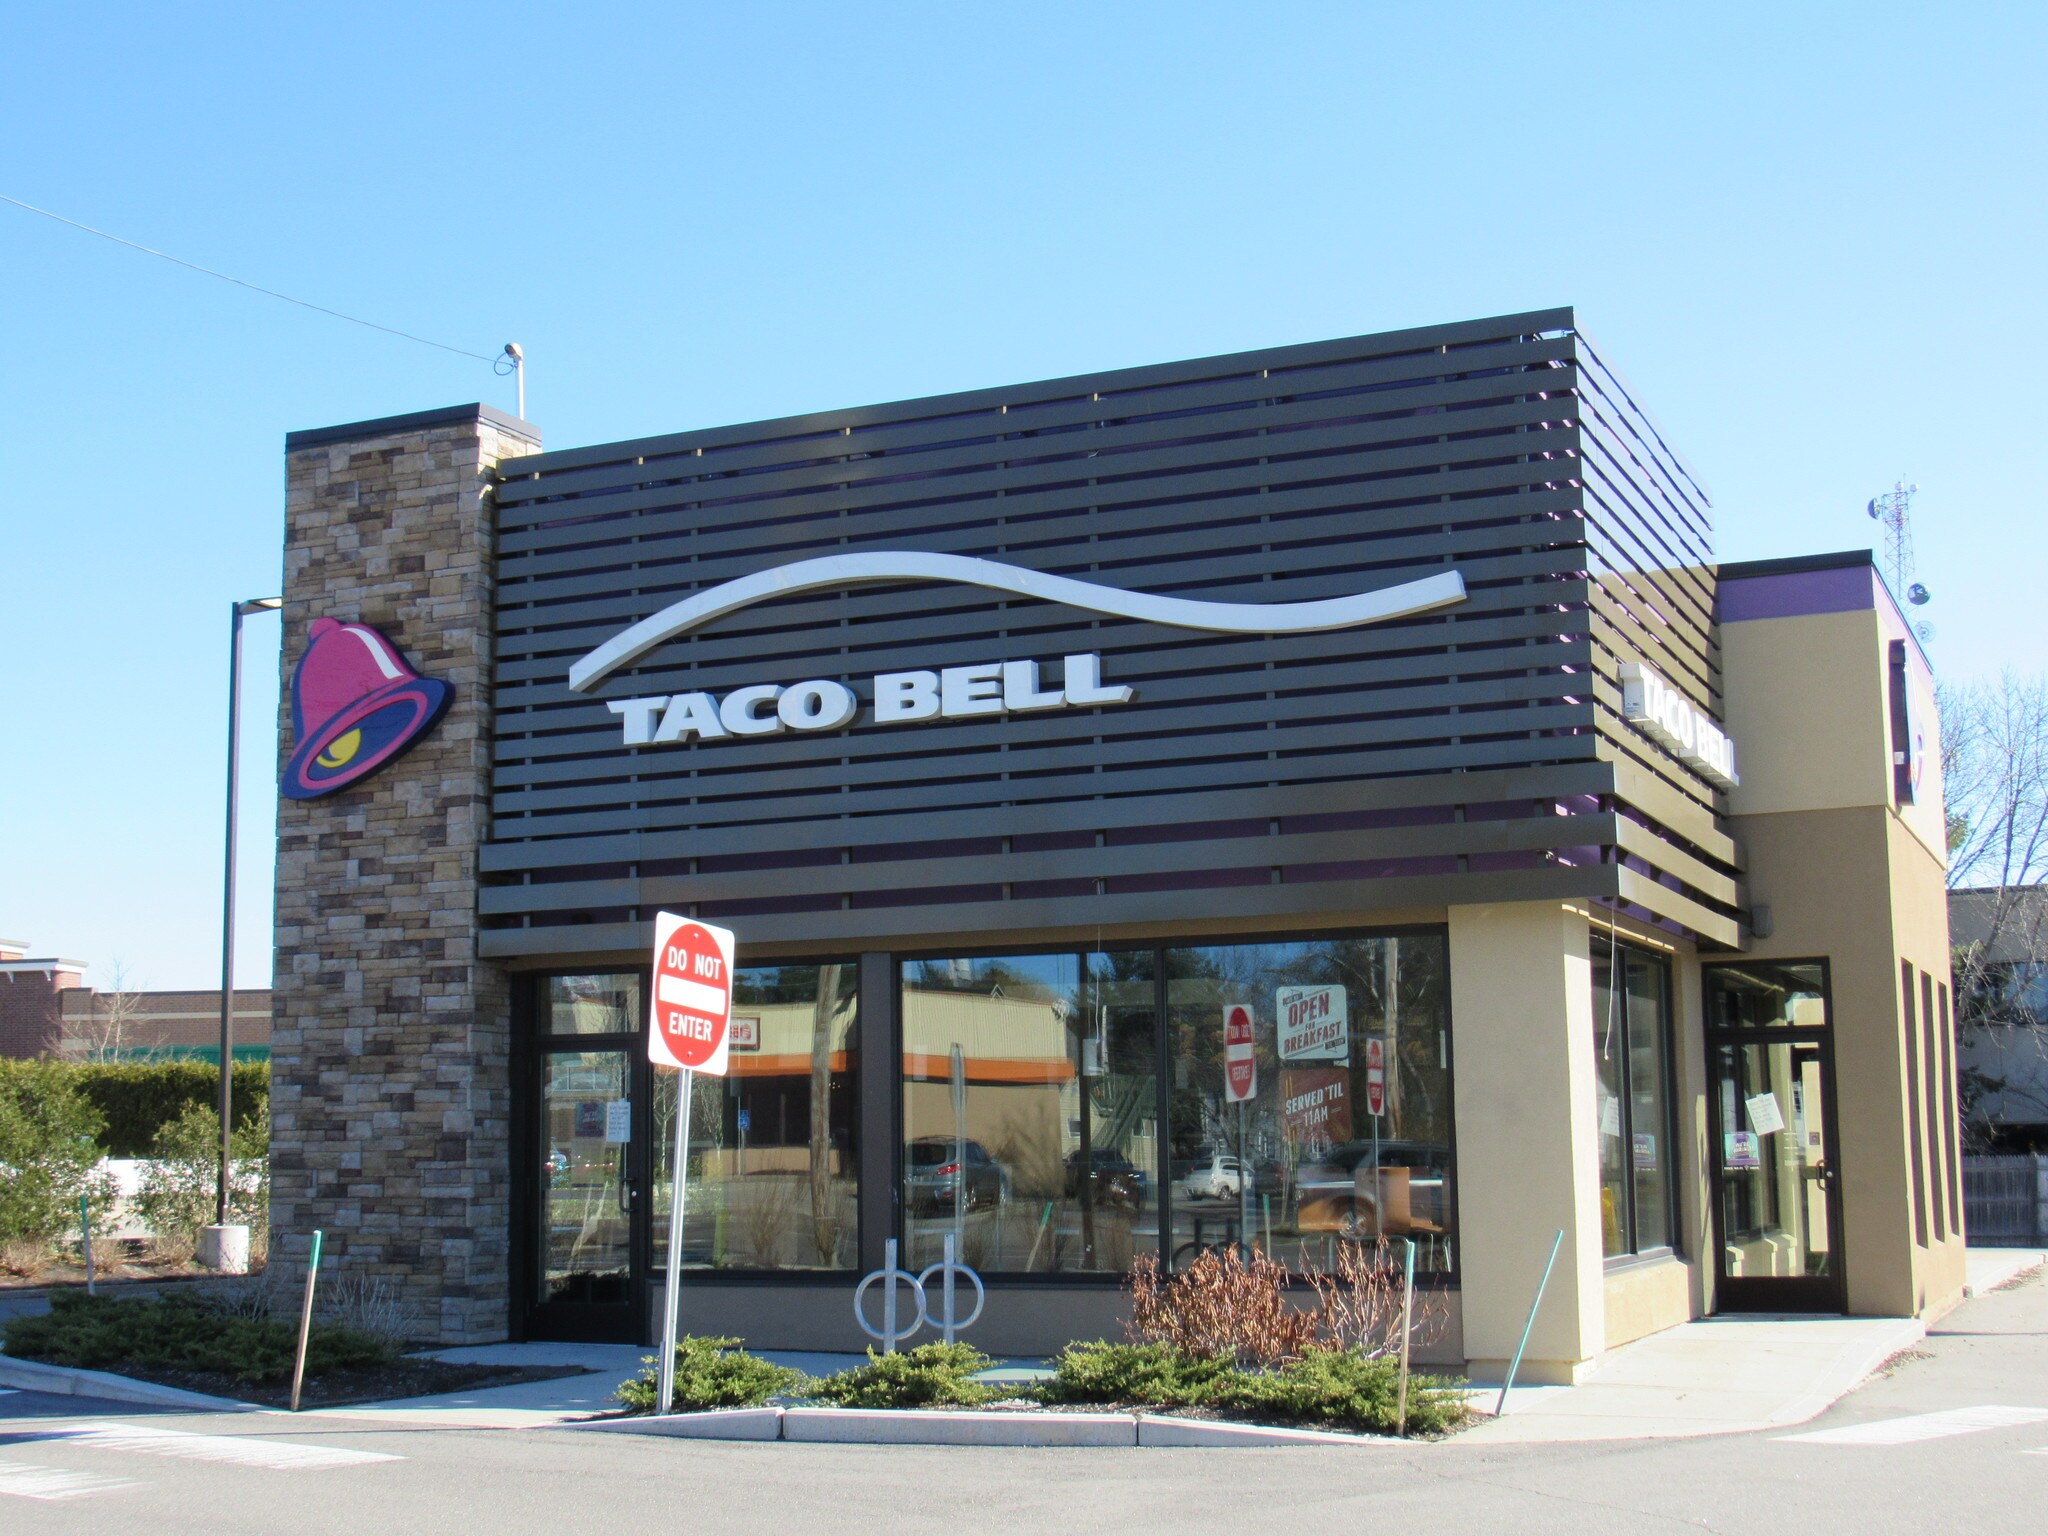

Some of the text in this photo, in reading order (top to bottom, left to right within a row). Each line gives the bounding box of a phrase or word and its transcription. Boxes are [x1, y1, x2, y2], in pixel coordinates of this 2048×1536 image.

[606, 653, 1133, 745] TACO BELL
[1637, 662, 1738, 786] TACO BELL
[667, 945, 722, 980] DO NOT
[668, 1011, 714, 1042] ENTER
[1288, 992, 1330, 1028] OPEN
[1284, 1021, 1342, 1054] BREAKFAST
[1285, 1088, 1324, 1115] SERVED
[1324, 1082, 1344, 1101] 'TIL
[1303, 1105, 1328, 1127] 11AM
